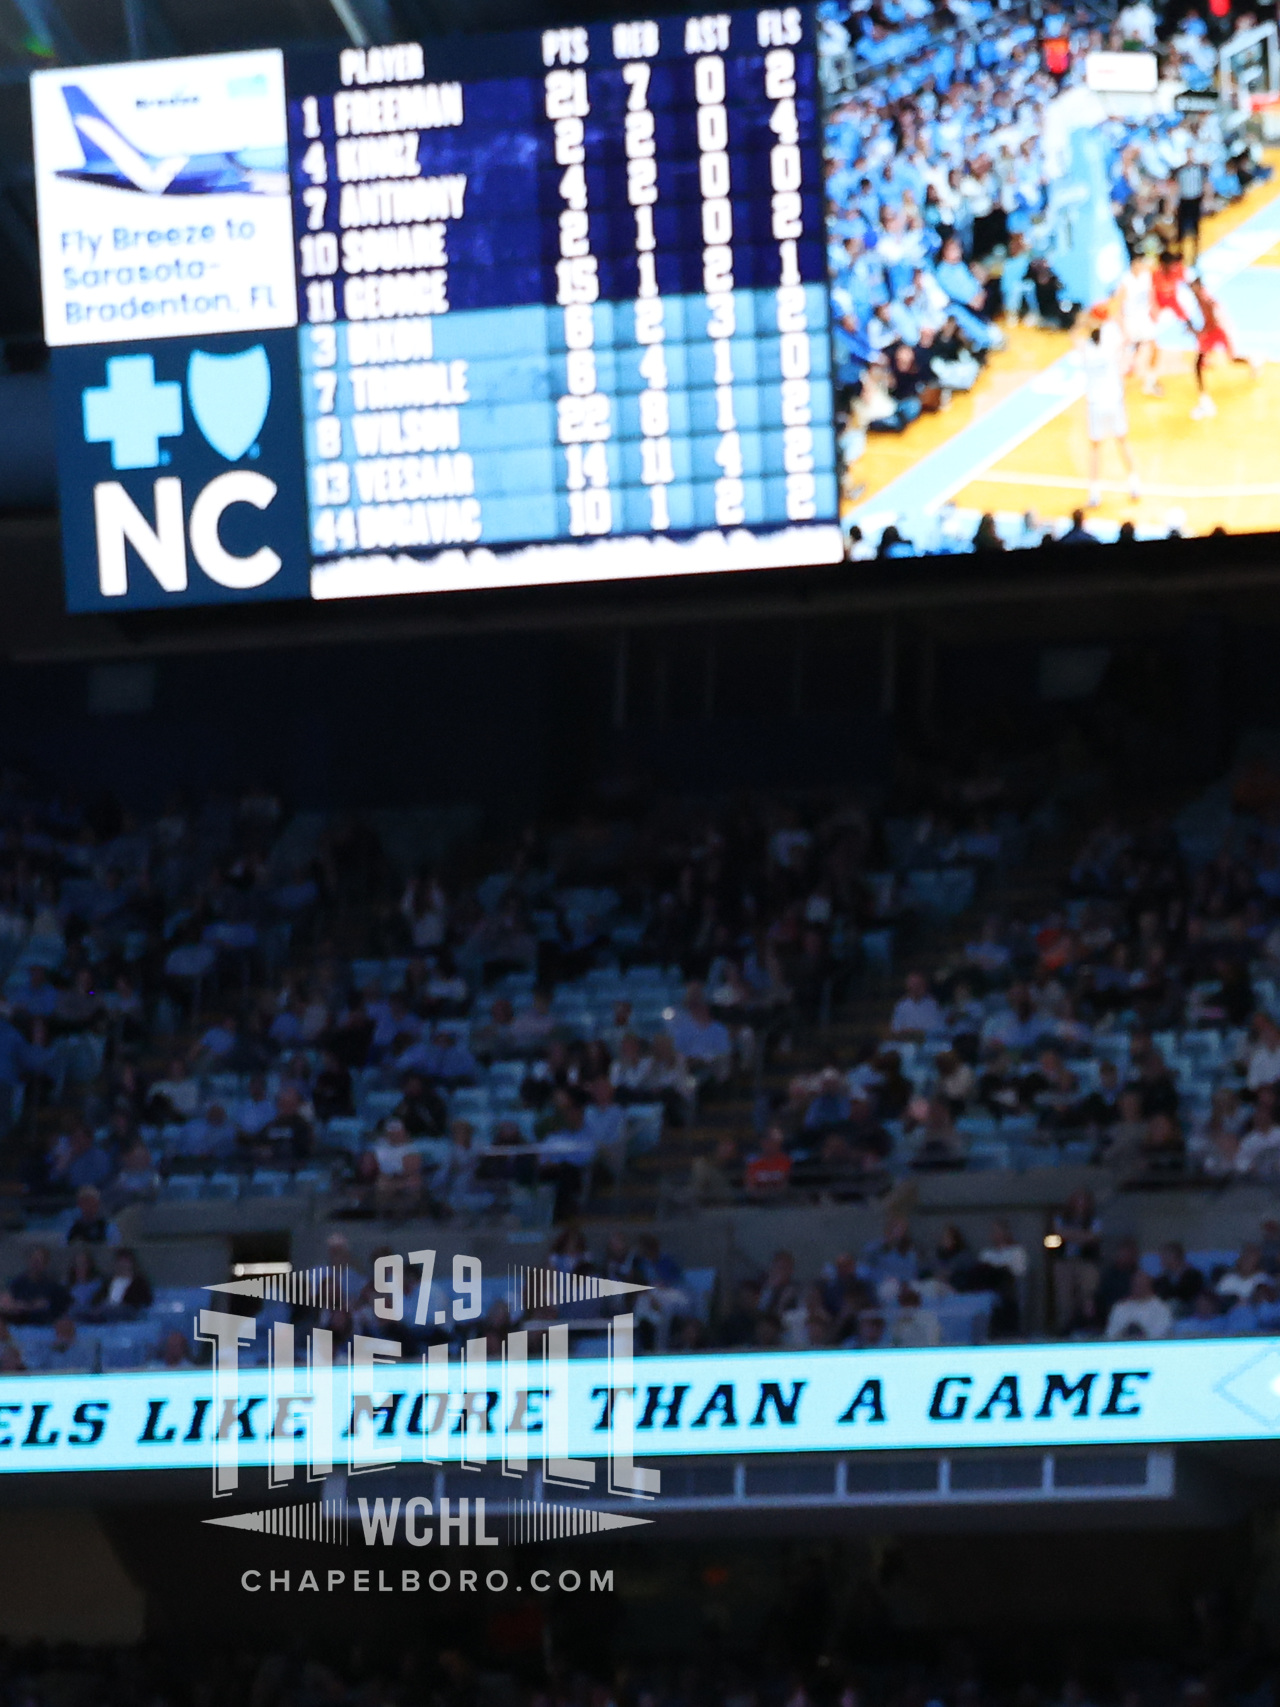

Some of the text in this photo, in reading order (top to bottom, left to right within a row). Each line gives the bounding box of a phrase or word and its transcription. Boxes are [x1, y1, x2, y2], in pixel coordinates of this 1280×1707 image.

[542, 26, 589, 67] PTS
[685, 14, 731, 54] AST
[757, 7, 802, 47] FLS
[303, 95, 321, 139] 1
[545, 68, 590, 119] 21
[623, 62, 651, 112] 7
[695, 55, 725, 104] 0
[765, 49, 796, 100] 2
[303, 140, 327, 184] 4
[554, 117, 585, 165] 2
[625, 109, 656, 159] 2
[697, 104, 728, 151] 0
[769, 98, 799, 145] 4
[303, 185, 327, 231] 7
[559, 163, 588, 211] 4
[627, 157, 658, 206] 2
[700, 151, 730, 199] 0
[770, 144, 801, 192] 0
[61, 219, 255, 263] Fly Breeze to
[64, 258, 219, 289] Sarasota-
[300, 231, 339, 278] 10
[559, 209, 589, 257] 2
[635, 204, 656, 252] 1
[702, 198, 733, 246] 0
[771, 191, 803, 239] 2
[306, 279, 336, 323] 11
[556, 255, 599, 305] 15
[637, 252, 658, 298] 1
[703, 244, 734, 293] 2
[780, 239, 800, 287] 1
[310, 325, 337, 368] 3
[634, 296, 665, 344] 2
[706, 290, 735, 338] 3
[776, 284, 807, 332] 2
[312, 370, 338, 413] 7
[639, 343, 667, 390] 4
[713, 338, 734, 385] 1
[779, 332, 810, 379] 0
[557, 393, 611, 443] 22
[716, 383, 736, 431] 1
[781, 378, 812, 425] 2
[311, 462, 350, 507] 13
[565, 441, 609, 490] 14
[640, 436, 675, 485] 11
[714, 430, 742, 478] 4
[784, 425, 814, 473] 2
[93, 469, 282, 596] NC
[312, 506, 357, 551] 44
[568, 486, 612, 536] 10
[650, 482, 670, 530] 1
[714, 476, 745, 526] 2
[786, 471, 816, 521] 2
[137, 1395, 315, 1444] LIKE
[342, 1389, 552, 1437] MORE
[591, 1380, 807, 1430] THAN
[837, 1378, 886, 1424] A
[927, 1371, 1151, 1421] GAME
